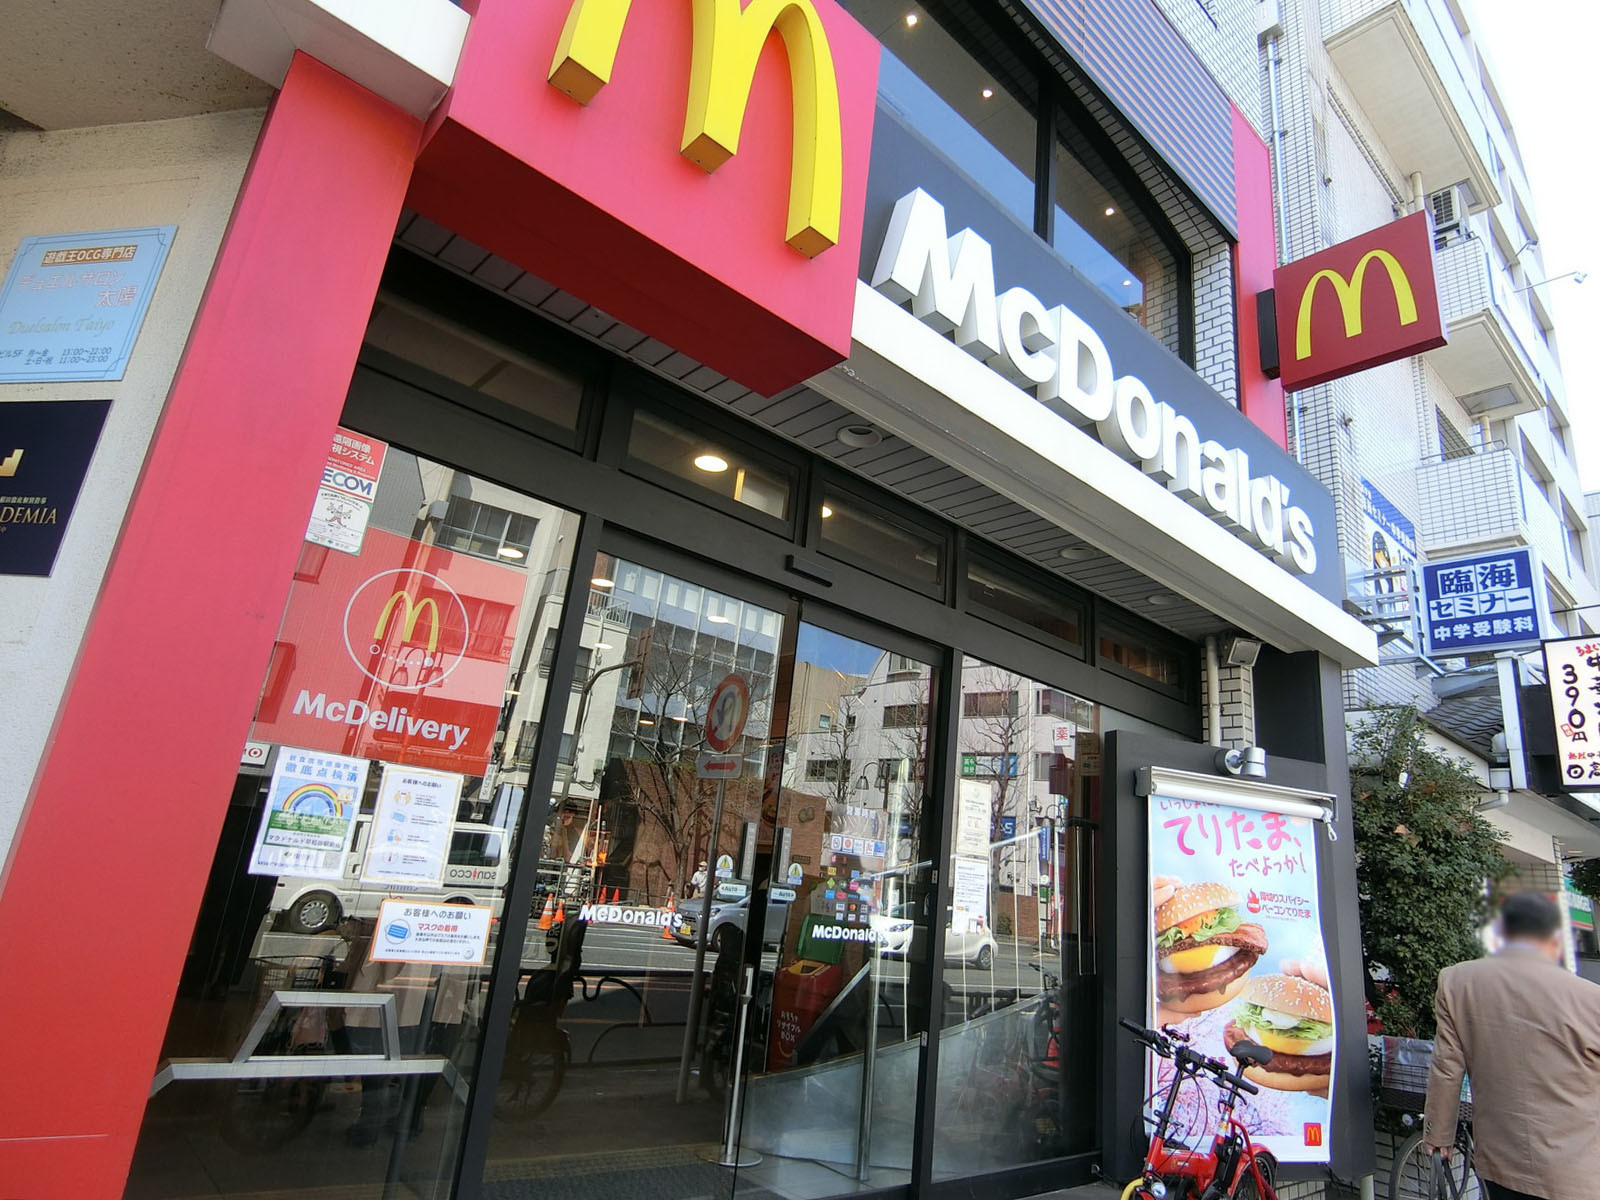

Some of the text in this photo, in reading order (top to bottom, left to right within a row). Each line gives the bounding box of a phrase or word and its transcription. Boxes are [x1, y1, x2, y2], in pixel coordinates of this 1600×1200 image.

[870, 186, 1318, 576] McDonald's
[331, 444, 375, 466] 視システム
[1440, 562, 1516, 596] 臨海
[1430, 592, 1531, 619] セミナー
[1434, 615, 1534, 642] 中学受験科
[293, 690, 470, 749] McDelivery
[1163, 811, 1303, 857] てりたま、
[403, 908, 471, 920] お客様へのお願い
[579, 905, 684, 930] McDonald's
[781, 1030, 796, 1043] BOX
